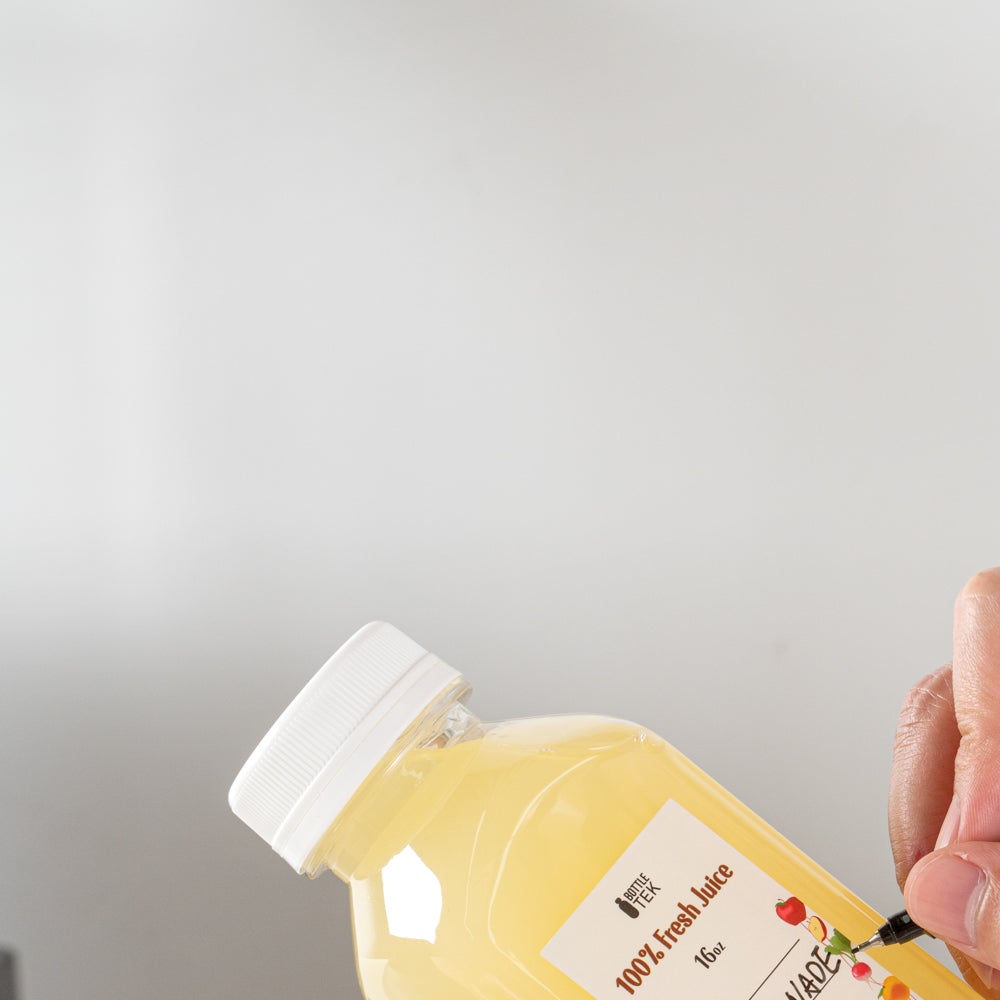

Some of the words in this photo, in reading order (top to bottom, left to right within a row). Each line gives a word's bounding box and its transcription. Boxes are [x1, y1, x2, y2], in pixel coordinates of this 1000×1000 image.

[623, 872, 650, 901] BOTTLE
[632, 881, 661, 908] TEK
[616, 943, 665, 995] 100%
[652, 901, 701, 950] Fresh
[690, 864, 734, 908] Juice
[694, 942, 726, 969] 16oz
